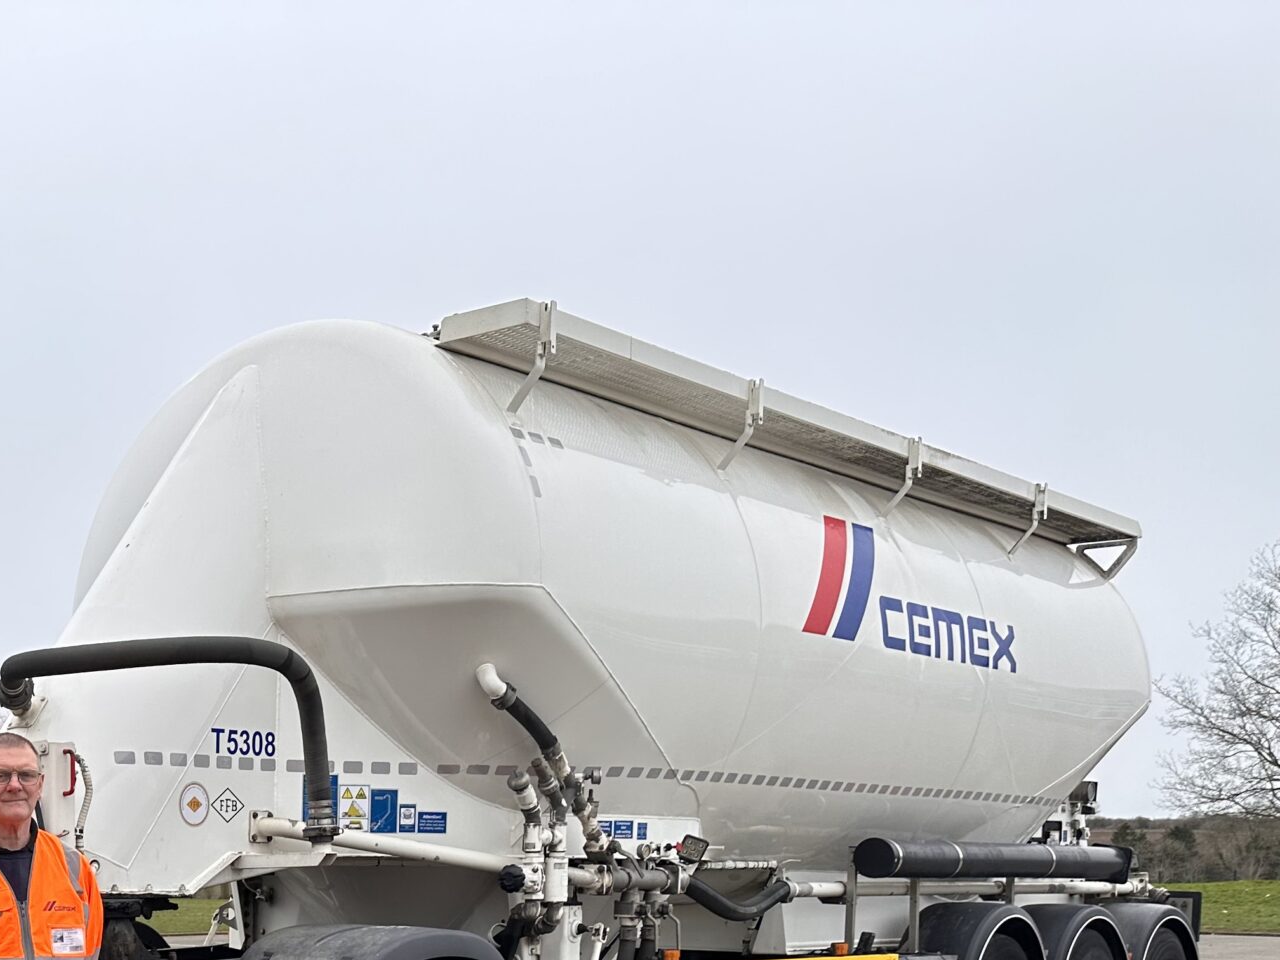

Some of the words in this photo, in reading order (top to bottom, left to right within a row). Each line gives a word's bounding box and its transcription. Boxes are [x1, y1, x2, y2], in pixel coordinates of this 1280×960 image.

[879, 595, 1017, 673] CEMEX
[211, 727, 276, 757] T5308
[219, 798, 238, 813] FFB
